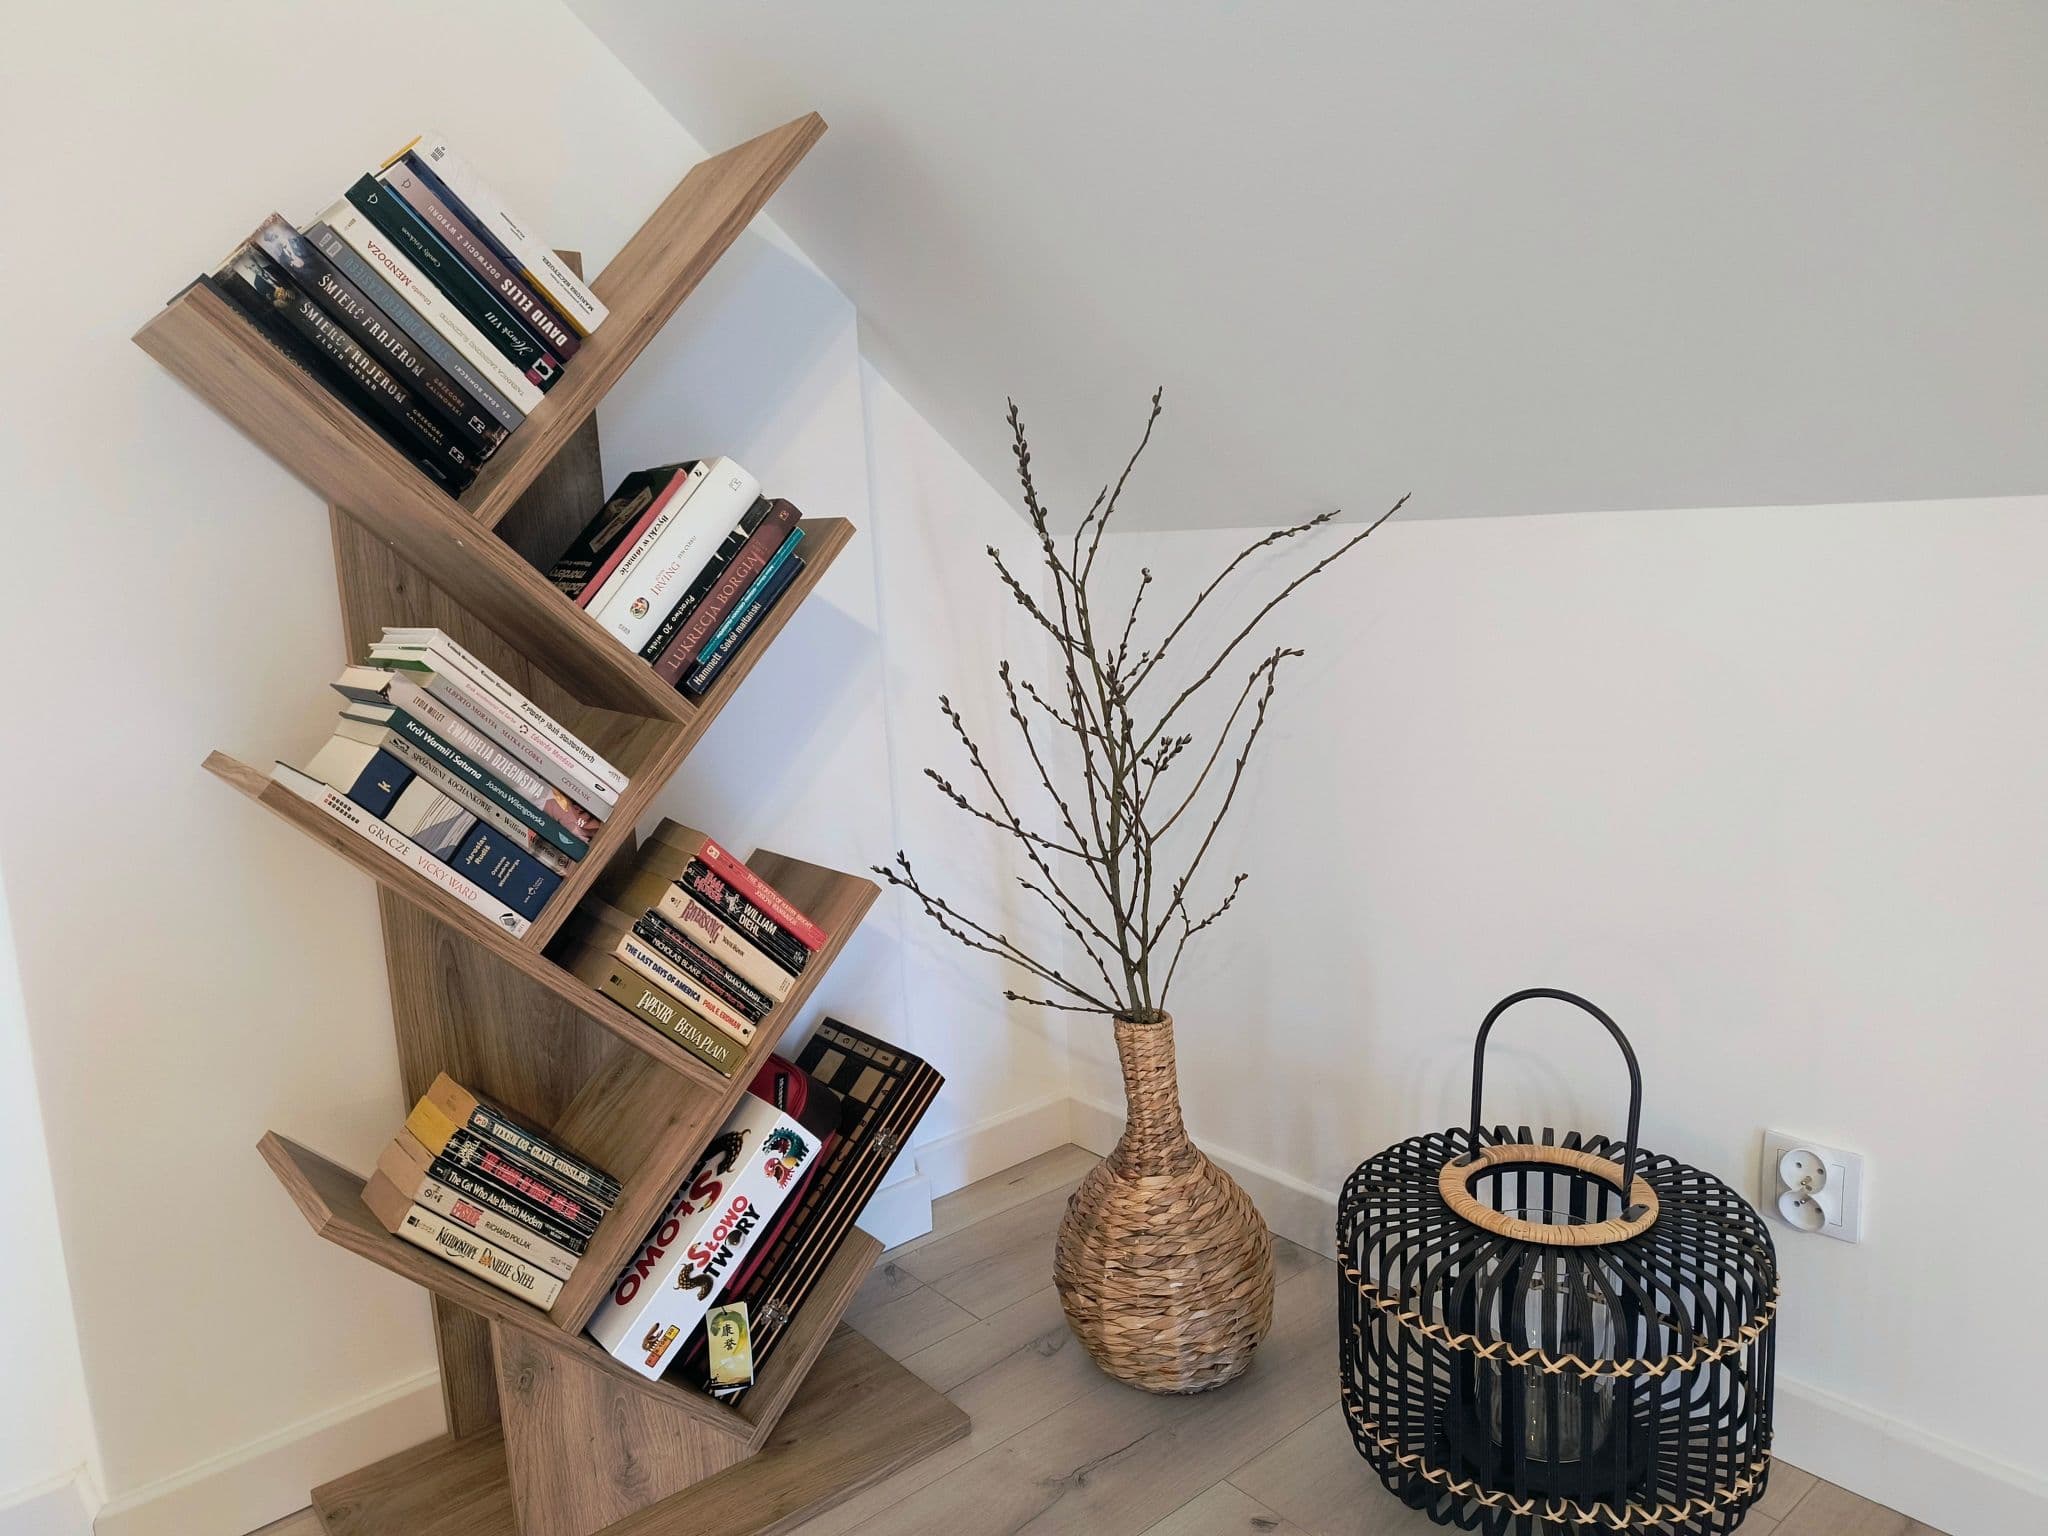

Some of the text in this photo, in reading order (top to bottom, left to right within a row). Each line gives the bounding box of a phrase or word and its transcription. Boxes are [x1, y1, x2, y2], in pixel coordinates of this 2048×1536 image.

[399, 225, 423, 250] Erickson
[426, 204, 457, 235] WYBORU
[365, 238, 412, 287] MENDOZA
[499, 277, 534, 312] ELLIS
[360, 314, 427, 377] FRAJEROM
[483, 309, 534, 359] Henryk VIII
[529, 307, 568, 347] DAVID
[342, 342, 408, 404] FRAJEROM
[453, 364, 483, 393] BONIECKI
[424, 380, 463, 417] KALINOWSKI
[482, 391, 500, 409] ADAM
[405, 411, 443, 447] KALINOWSKI
[640, 537, 650, 547] w
[645, 513, 669, 540] Byczki
[648, 559, 682, 596] IRVING
[645, 594, 695, 654] Piractwo 20 wieku
[665, 602, 723, 670] LUKRECJA
[715, 552, 758, 604] BORGIA
[691, 650, 722, 686] Hammett
[443, 684, 499, 729] ALBERTO MORAVIA
[405, 720, 424, 737] Król
[421, 732, 451, 756] Warmii
[451, 754, 483, 779] Saturna
[445, 719, 547, 799] EWANGELIA DZIECIŃSTWA
[446, 776, 493, 813] KOCHANKOWIE
[484, 780, 547, 827] Joanna Wilengowska
[366, 821, 411, 856] GRACZE
[502, 816, 528, 837] William
[463, 833, 488, 866] Jaroslav
[414, 854, 479, 903] VICKY WARD
[746, 872, 758, 884] THE
[736, 913, 763, 937] DIEHL
[741, 903, 778, 935] WILLIAM
[623, 942, 702, 1002] THE LAST DAYS OF AMERICA
[650, 937, 682, 962] NICHOLAS
[679, 958, 702, 977] BLAKE
[634, 988, 679, 1027] TAPESTRY
[740, 985, 761, 1002] MARSH
[701, 999, 716, 1013] PAUL
[717, 1010, 742, 1030] ERDMAN
[672, 1016, 730, 1064] BELVA PLAIN
[490, 1121, 531, 1152] VIXEN 03
[529, 1144, 591, 1187] CLIVE CUSSLER
[447, 1170, 544, 1230] The Cat Who Ate Danish Modern
[435, 1226, 481, 1261] KALEIDOSCOPE
[484, 1220, 532, 1250] RICHARD POLLAK
[686, 1195, 750, 1268] SŁOWO
[477, 1246, 516, 1279] DANIELLE
[509, 1262, 540, 1291] STEEL
